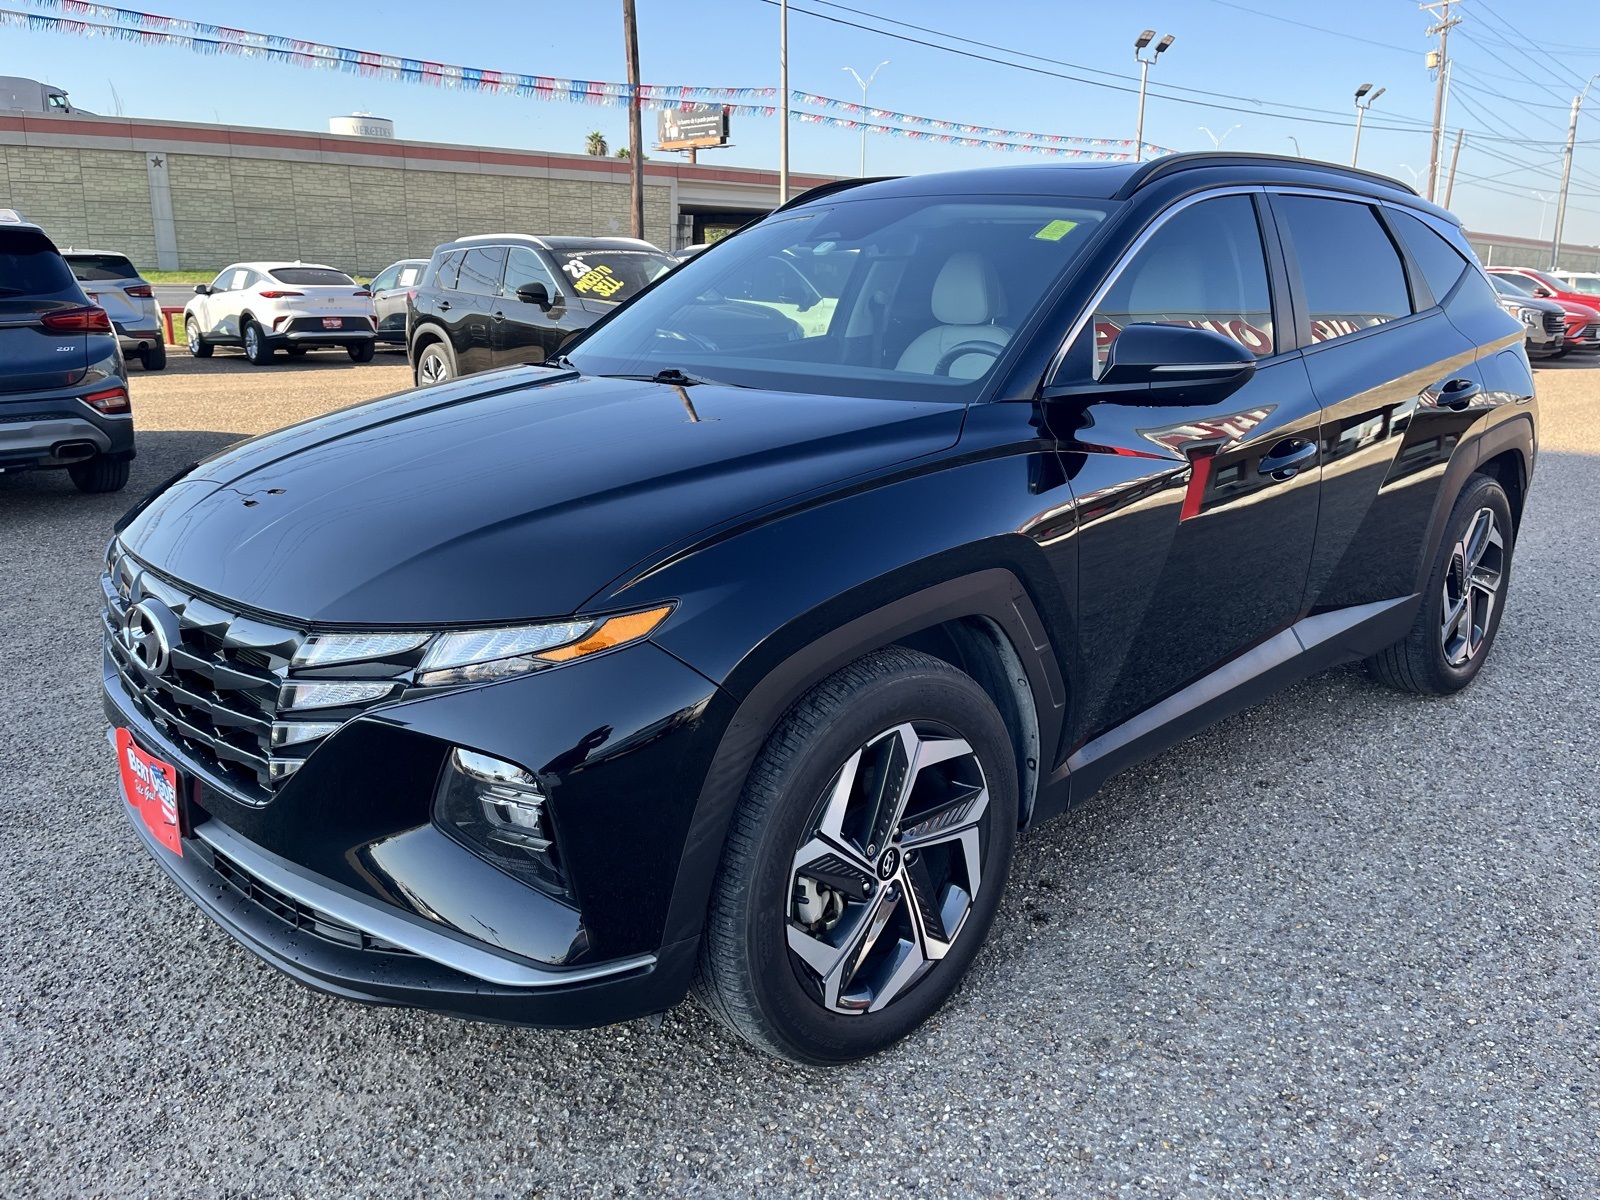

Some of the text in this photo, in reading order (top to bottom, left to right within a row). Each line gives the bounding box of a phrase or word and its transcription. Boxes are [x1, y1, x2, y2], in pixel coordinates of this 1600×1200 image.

[351, 125, 391, 137] MERCEDES
[573, 264, 613, 293] PRICED TO
[592, 276, 625, 297] SELL
[127, 748, 149, 783] BERT
[150, 769, 175, 807] OGDE
